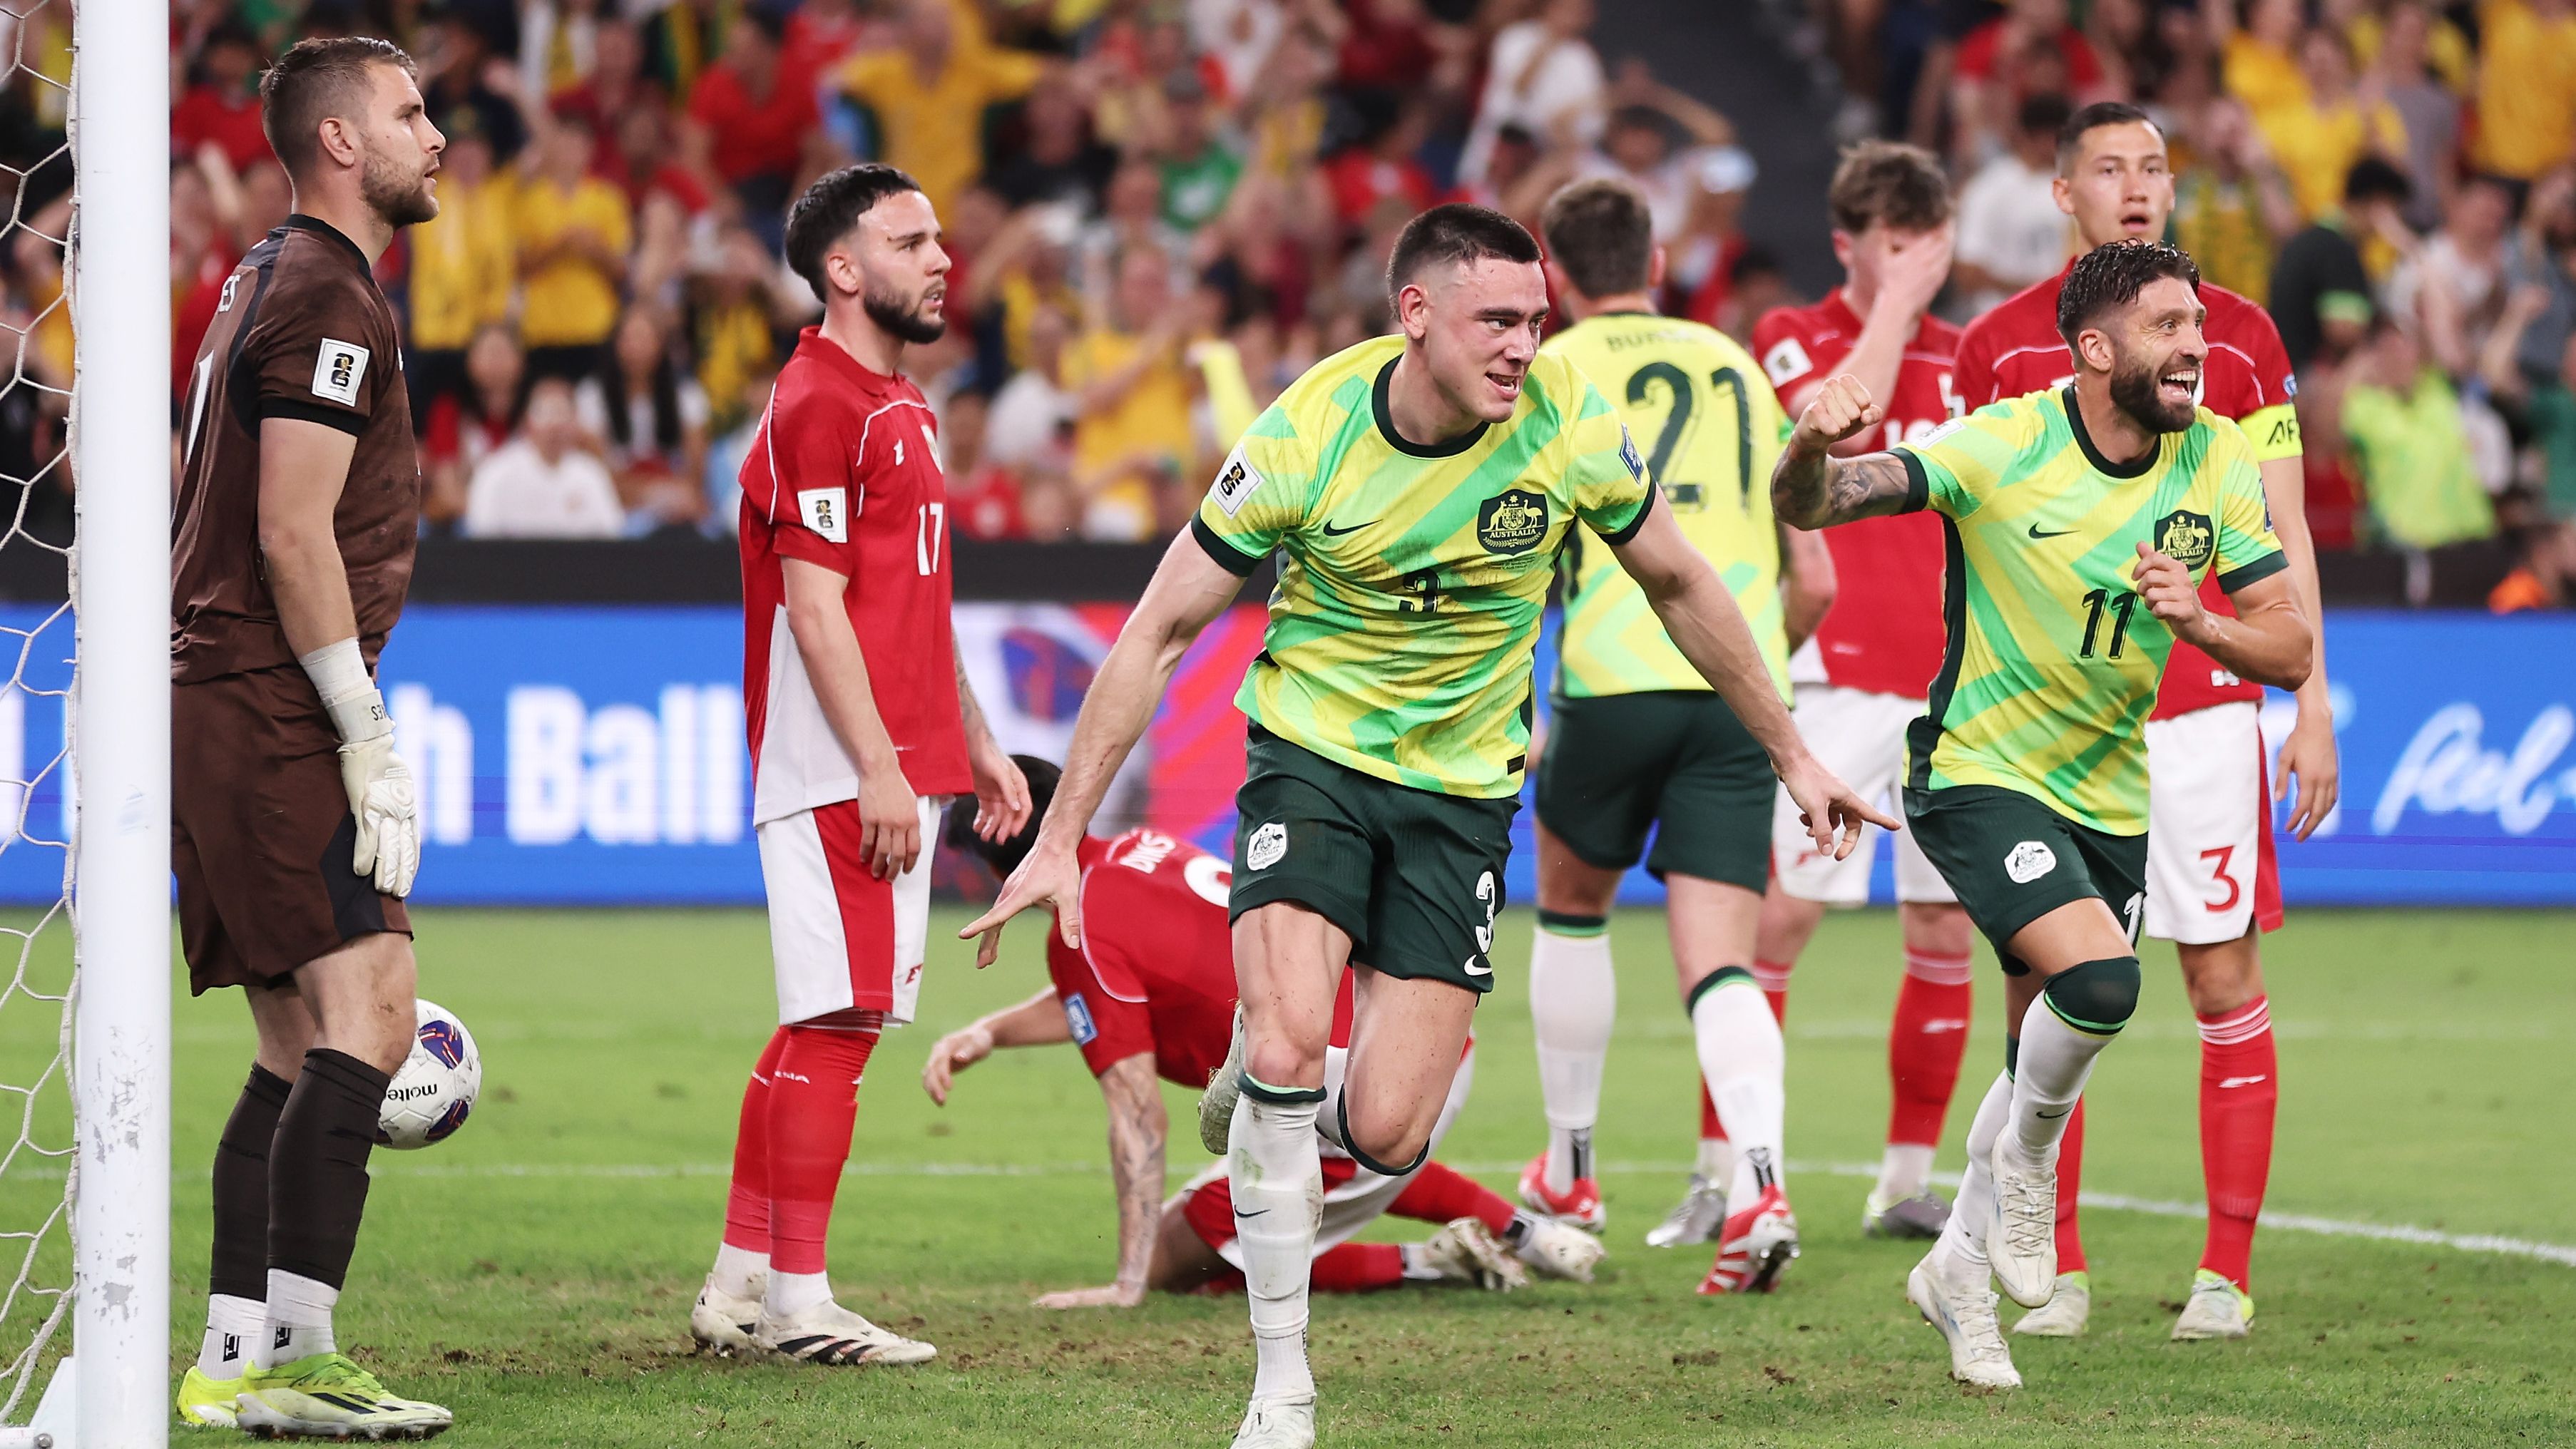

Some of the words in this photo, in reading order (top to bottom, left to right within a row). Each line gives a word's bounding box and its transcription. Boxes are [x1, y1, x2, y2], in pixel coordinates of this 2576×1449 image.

[218, 274, 241, 312] ES
[1626, 362, 1752, 511] 21
[2266, 419, 2296, 446] AF
[917, 501, 944, 576] 17
[1489, 528, 1536, 538] AUSTRALIA
[1398, 568, 1441, 613] 3
[2080, 589, 2139, 659] 11
[505, 681, 745, 847] Ball
[1475, 871, 1495, 953] 3
[2199, 844, 2240, 912] 3
[387, 1083, 438, 1102] molte
